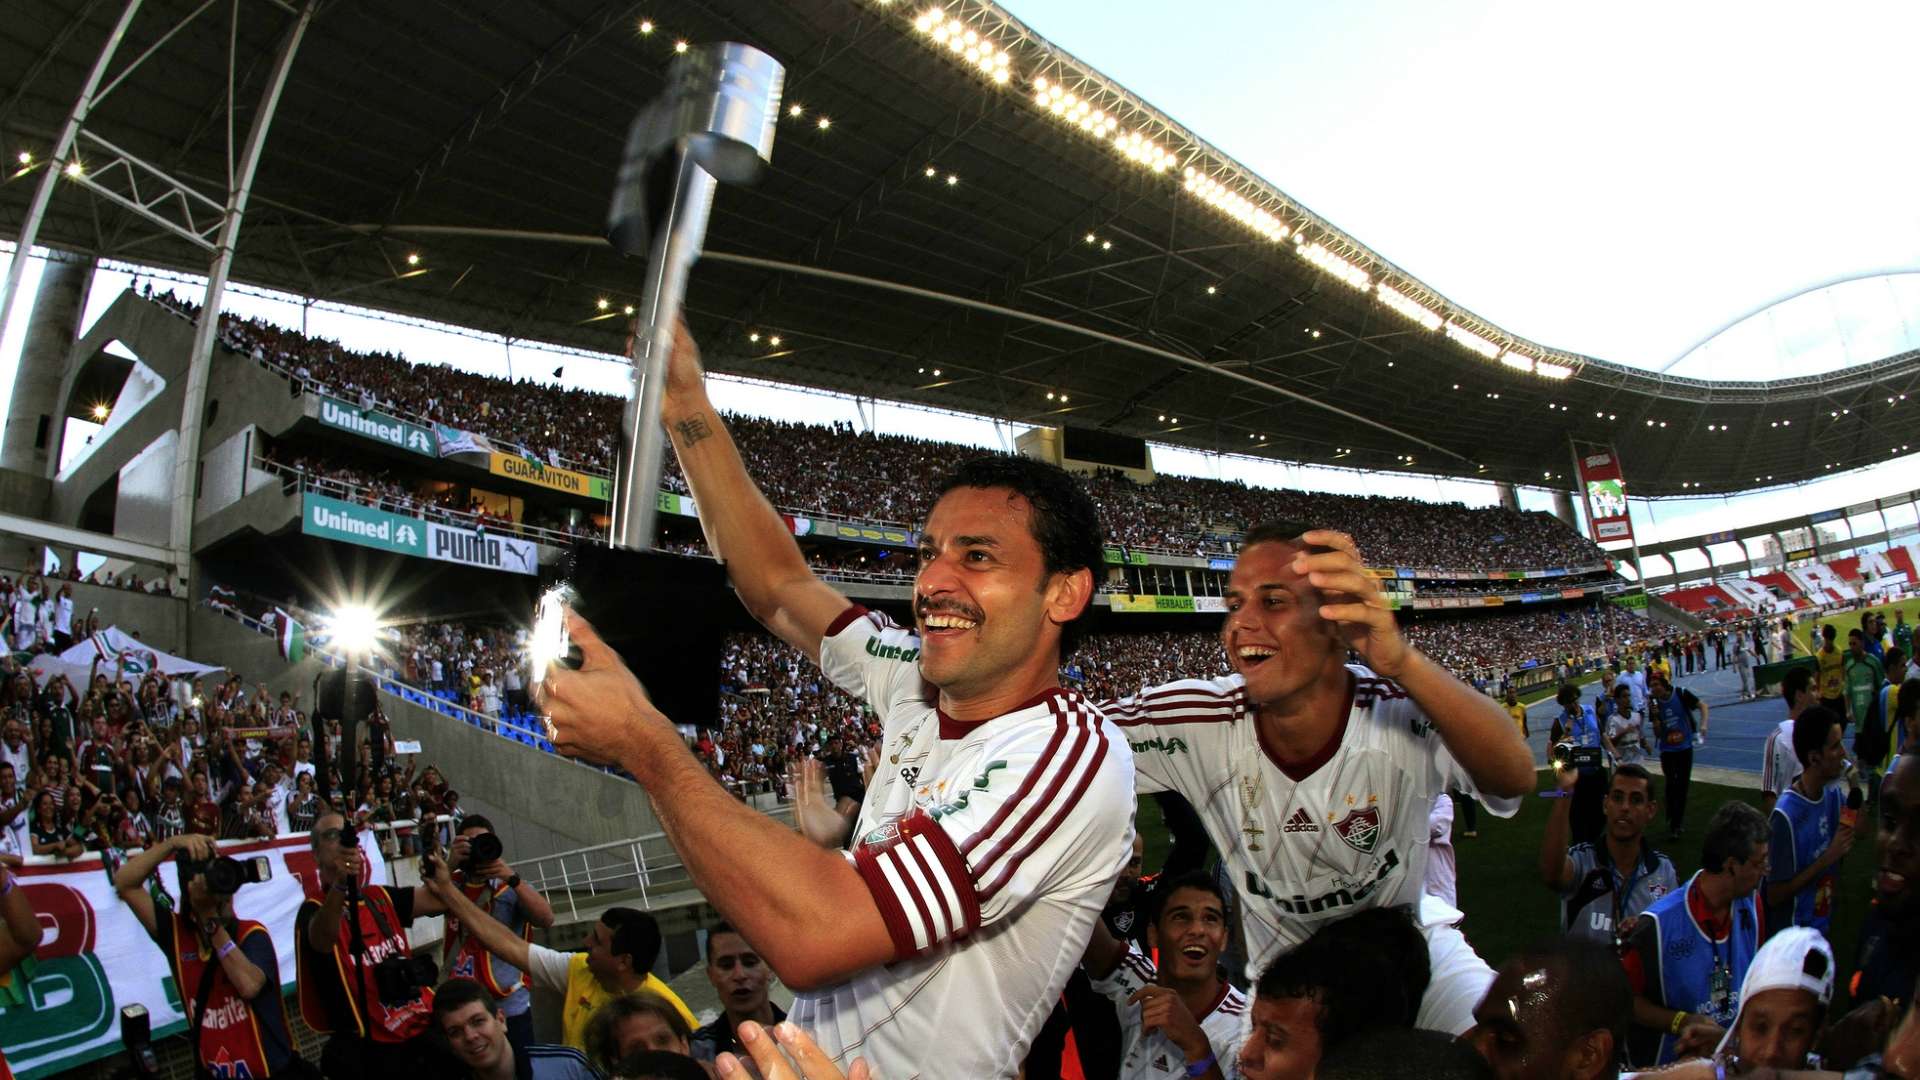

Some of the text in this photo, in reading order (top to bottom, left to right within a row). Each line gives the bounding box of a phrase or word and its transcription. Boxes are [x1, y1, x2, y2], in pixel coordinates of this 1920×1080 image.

[323, 401, 403, 444] Unimed
[503, 458, 580, 491] GUARAVITON
[313, 506, 390, 540] Unimed
[435, 528, 501, 567] PUMA
[1155, 597, 1194, 609] HERBALIFE
[1283, 823, 1319, 833] adidas
[1245, 848, 1399, 914] Unimed
